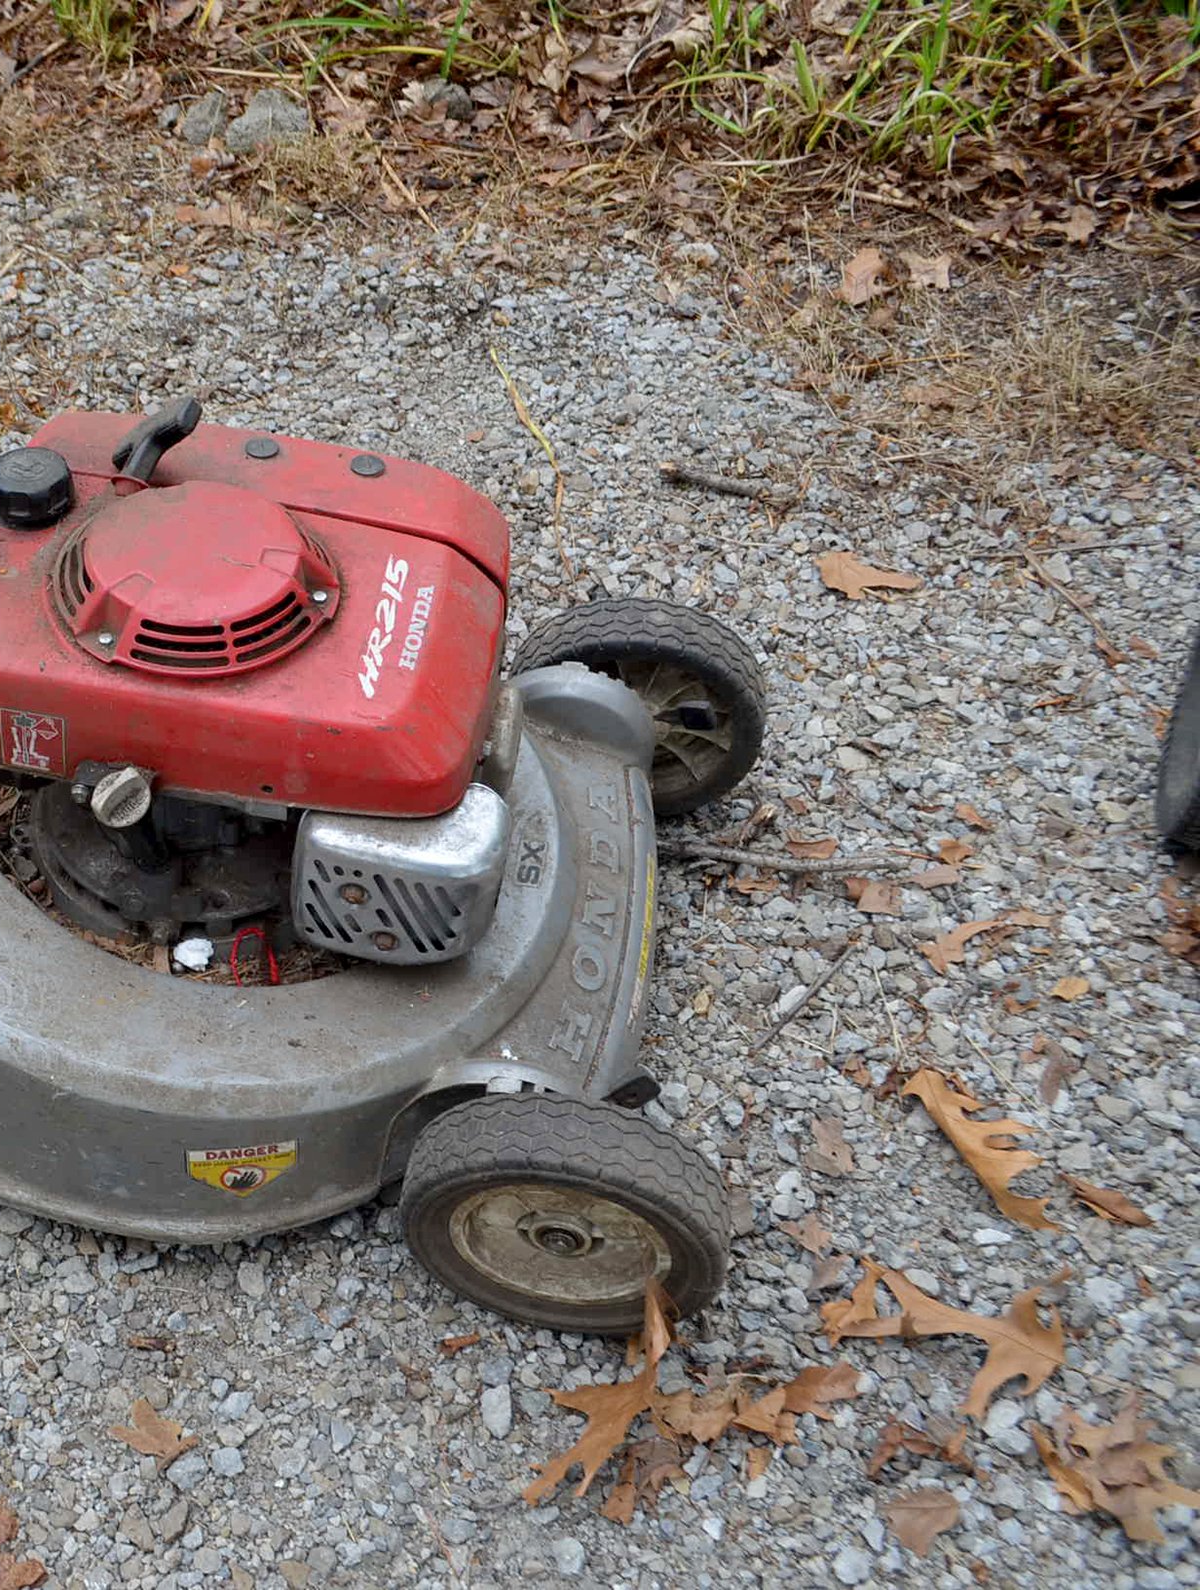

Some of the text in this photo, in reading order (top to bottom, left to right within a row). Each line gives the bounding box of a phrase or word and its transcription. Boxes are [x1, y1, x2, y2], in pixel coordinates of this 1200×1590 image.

[361, 554, 408, 699] HR215
[399, 584, 434, 669] HONDA
[518, 842, 544, 885] SX
[548, 783, 619, 1062] HONDA
[205, 1144, 279, 1160] DANGER
